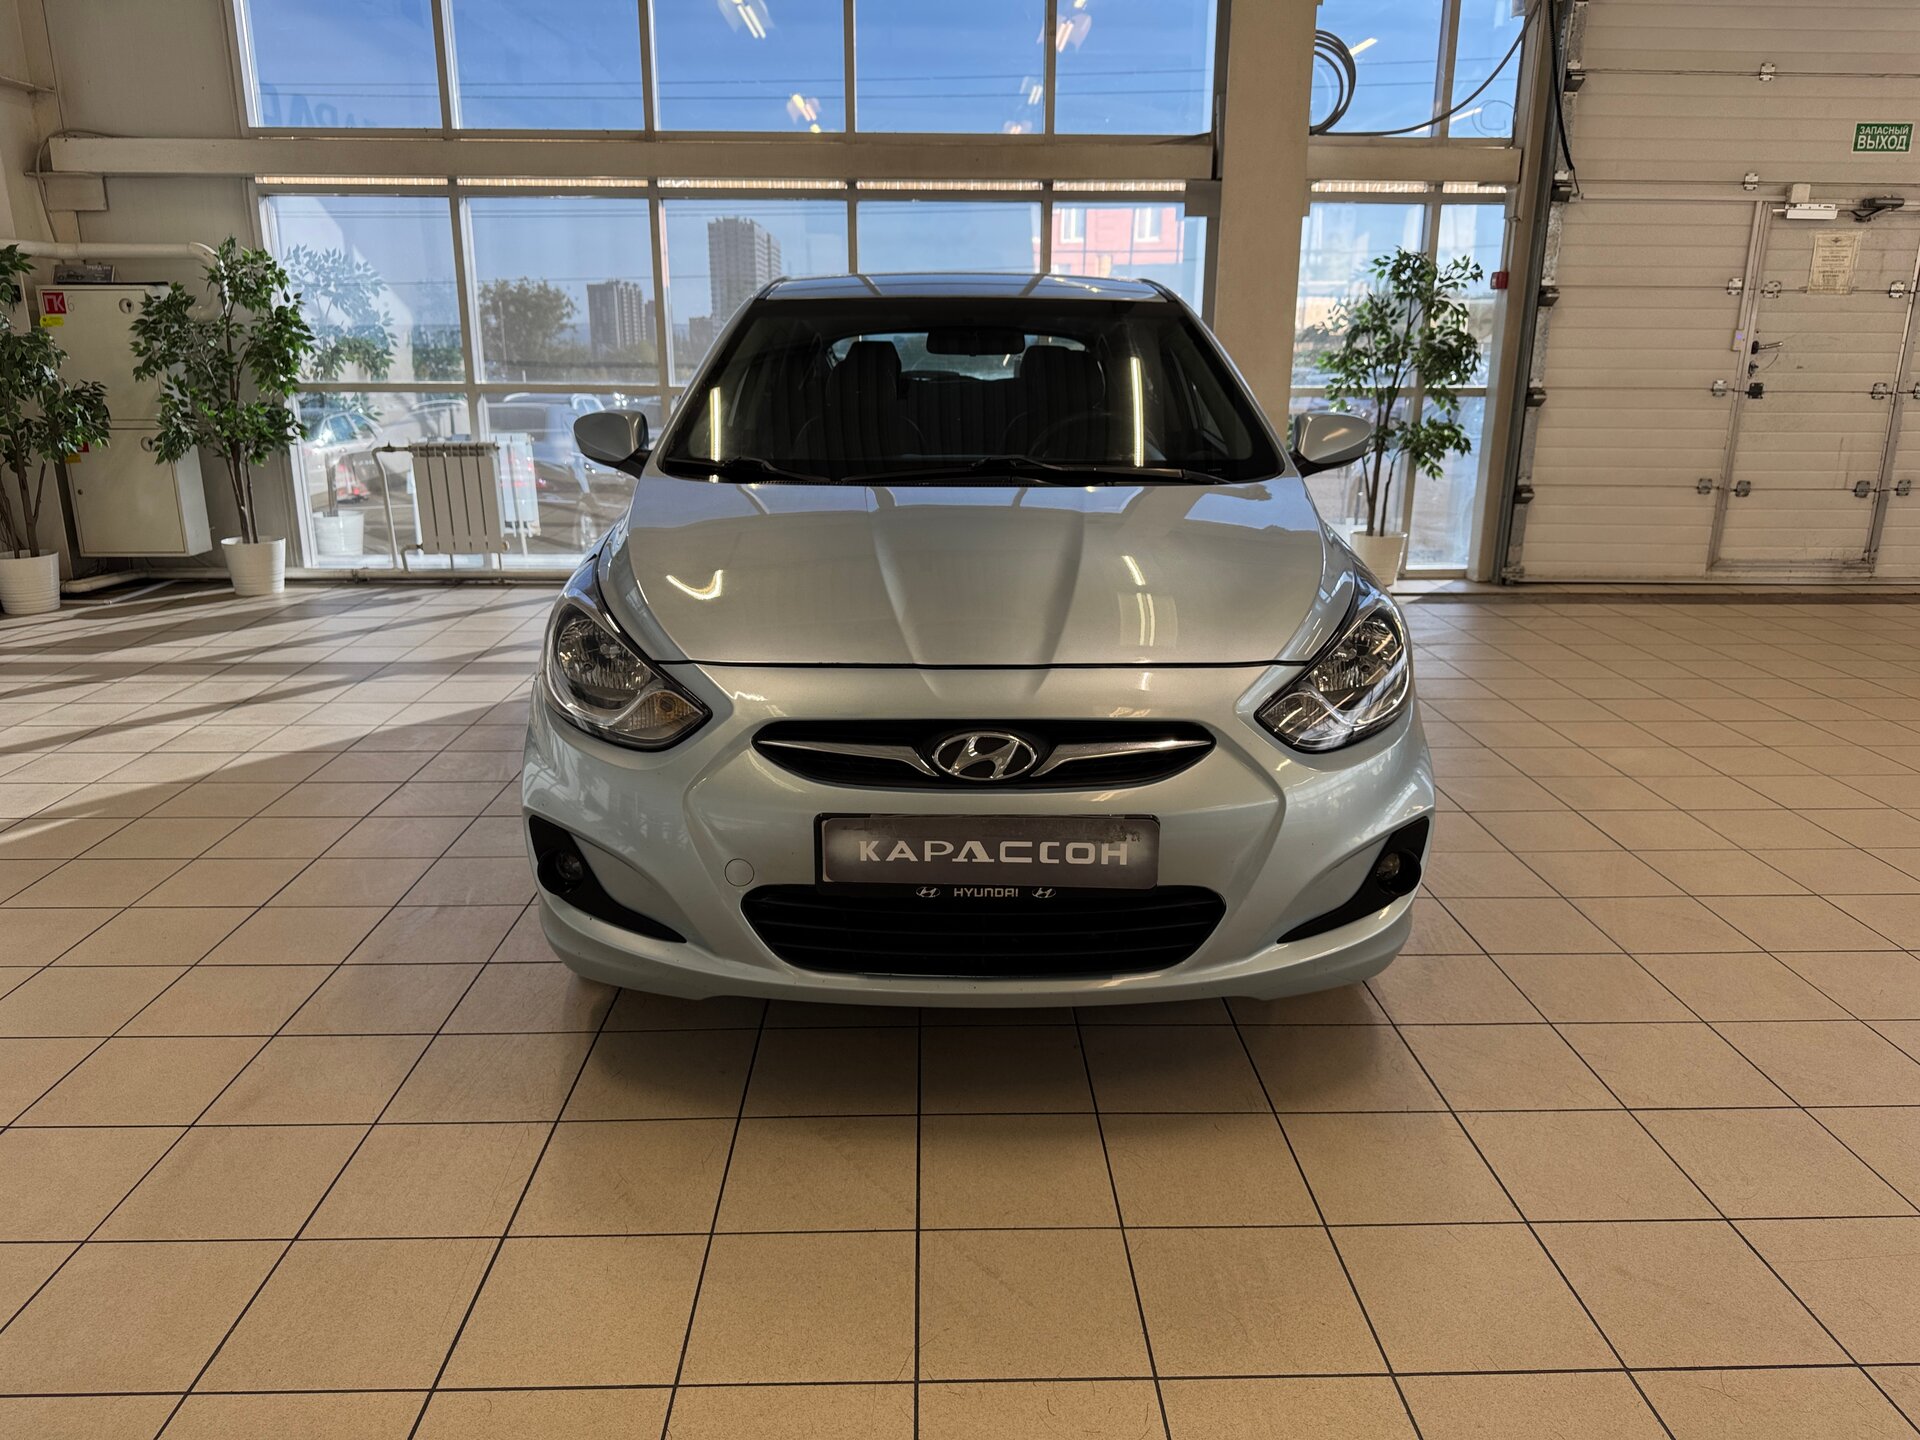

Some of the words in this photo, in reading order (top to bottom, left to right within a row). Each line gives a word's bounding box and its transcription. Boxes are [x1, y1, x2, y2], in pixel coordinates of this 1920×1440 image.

[1859, 125, 1909, 135] ЗАПАСНЫЙ
[1857, 135, 1907, 150] ВЫХОД
[44, 294, 65, 312] ПК
[858, 840, 1128, 866] КАРАССОН
[953, 887, 1019, 898] HYUNDAI
